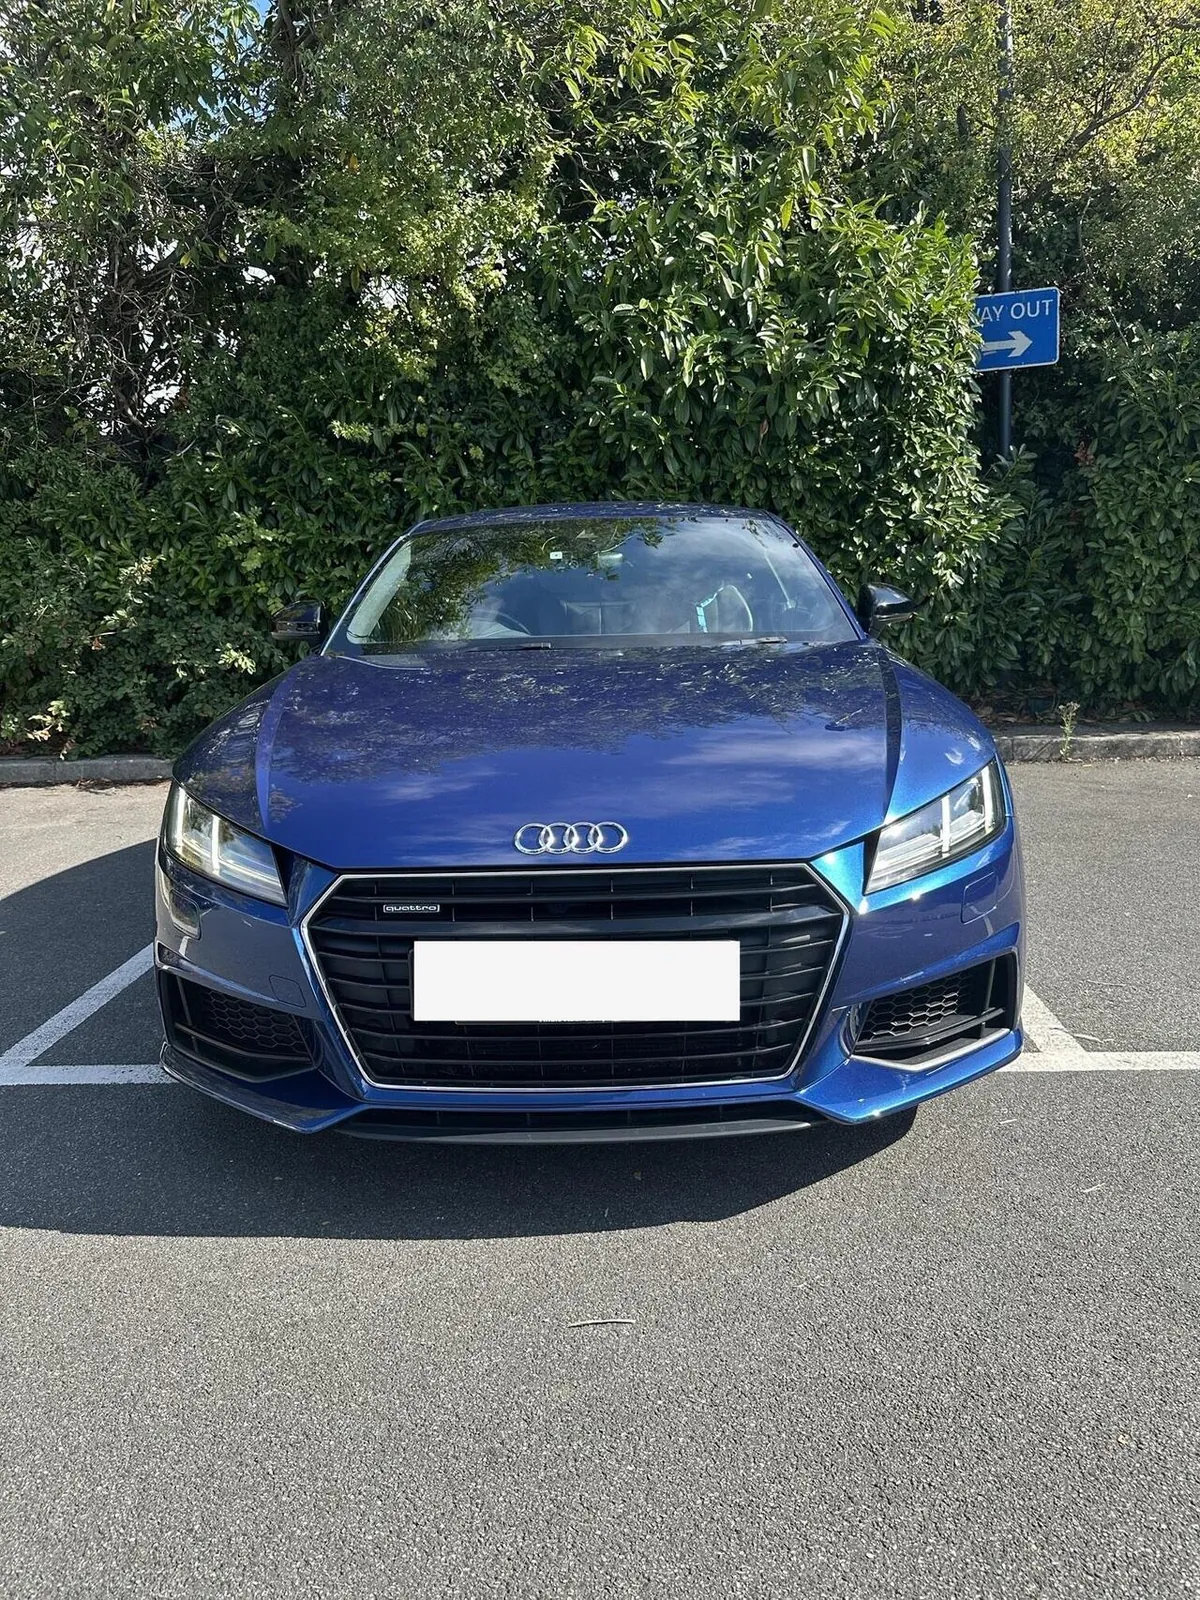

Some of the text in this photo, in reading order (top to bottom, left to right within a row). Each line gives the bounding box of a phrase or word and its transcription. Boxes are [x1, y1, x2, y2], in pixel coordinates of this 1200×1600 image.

[976, 299, 1053, 322] AY OUT
[385, 905, 437, 913] quattro
